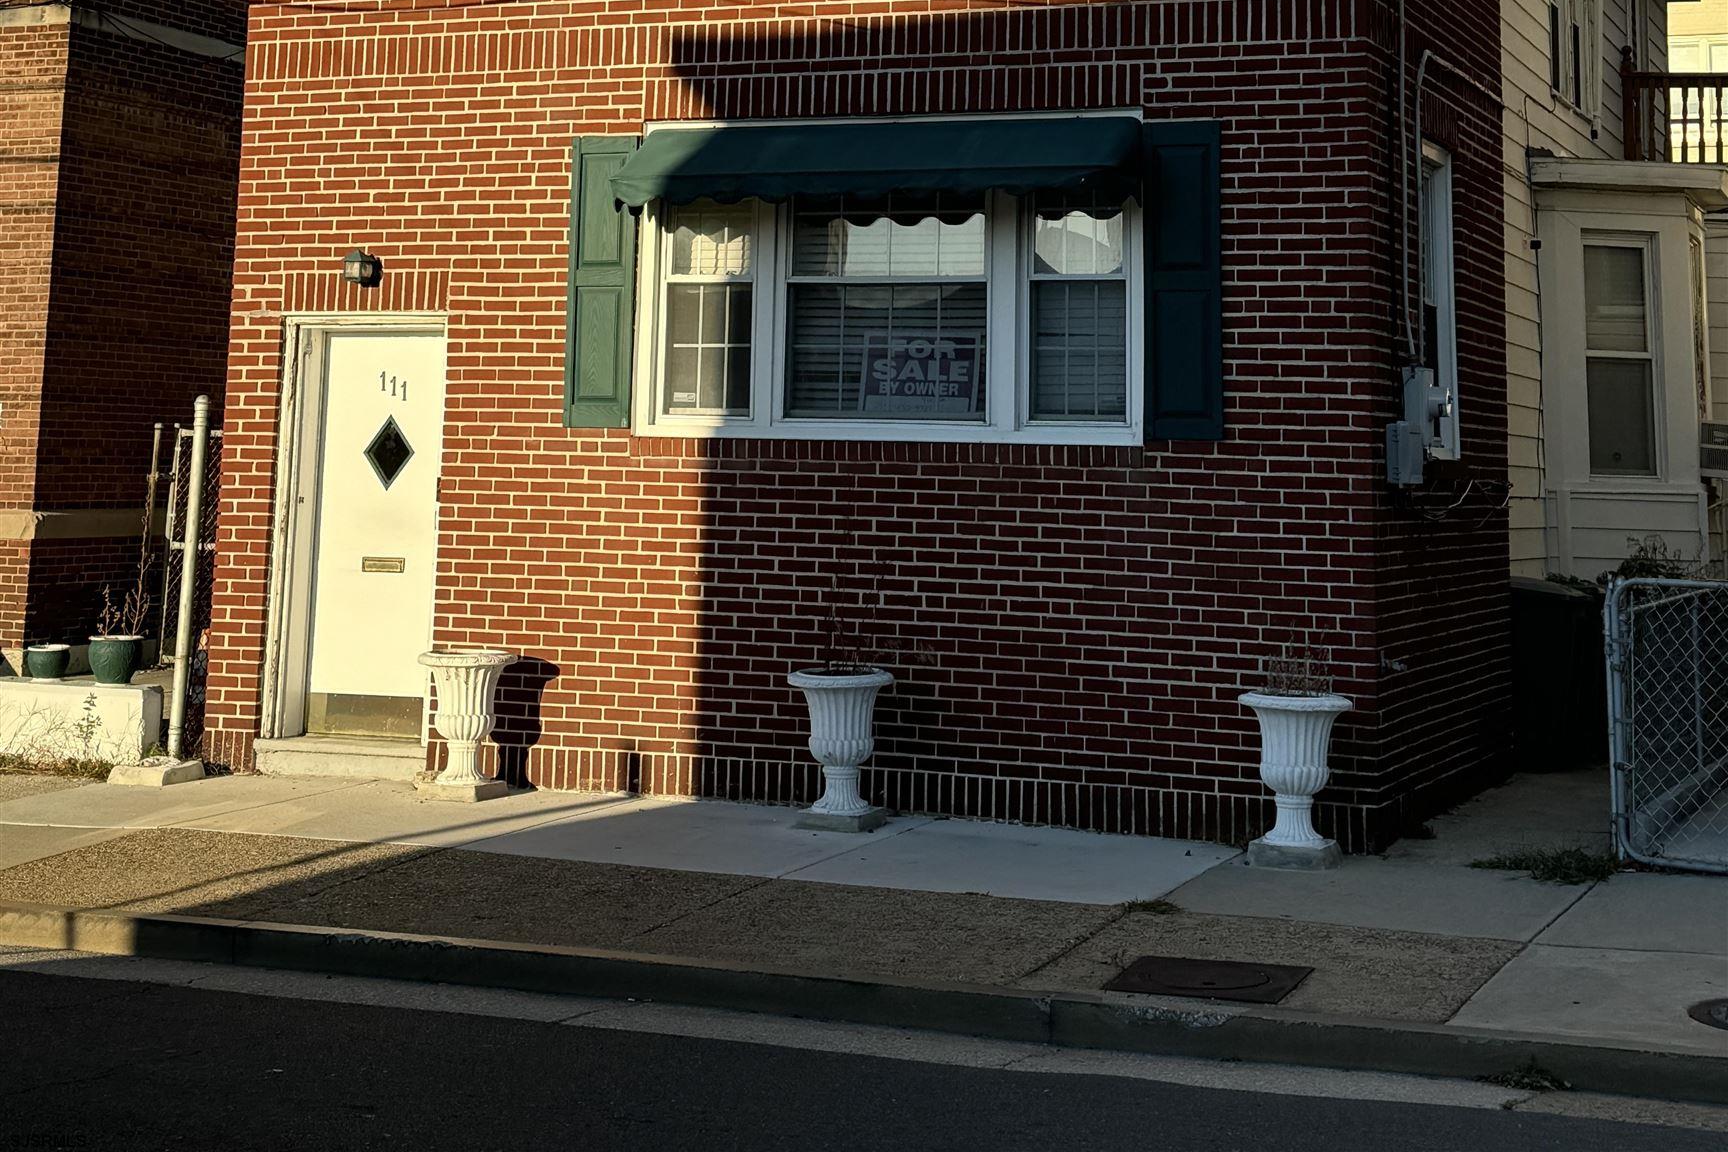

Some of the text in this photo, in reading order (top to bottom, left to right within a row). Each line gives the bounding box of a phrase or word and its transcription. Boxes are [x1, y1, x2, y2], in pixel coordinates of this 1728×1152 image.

[890, 339, 956, 359] FOR
[872, 358, 969, 382] SALE
[380, 370, 407, 402] 111
[879, 381, 959, 396] BY OWNER
